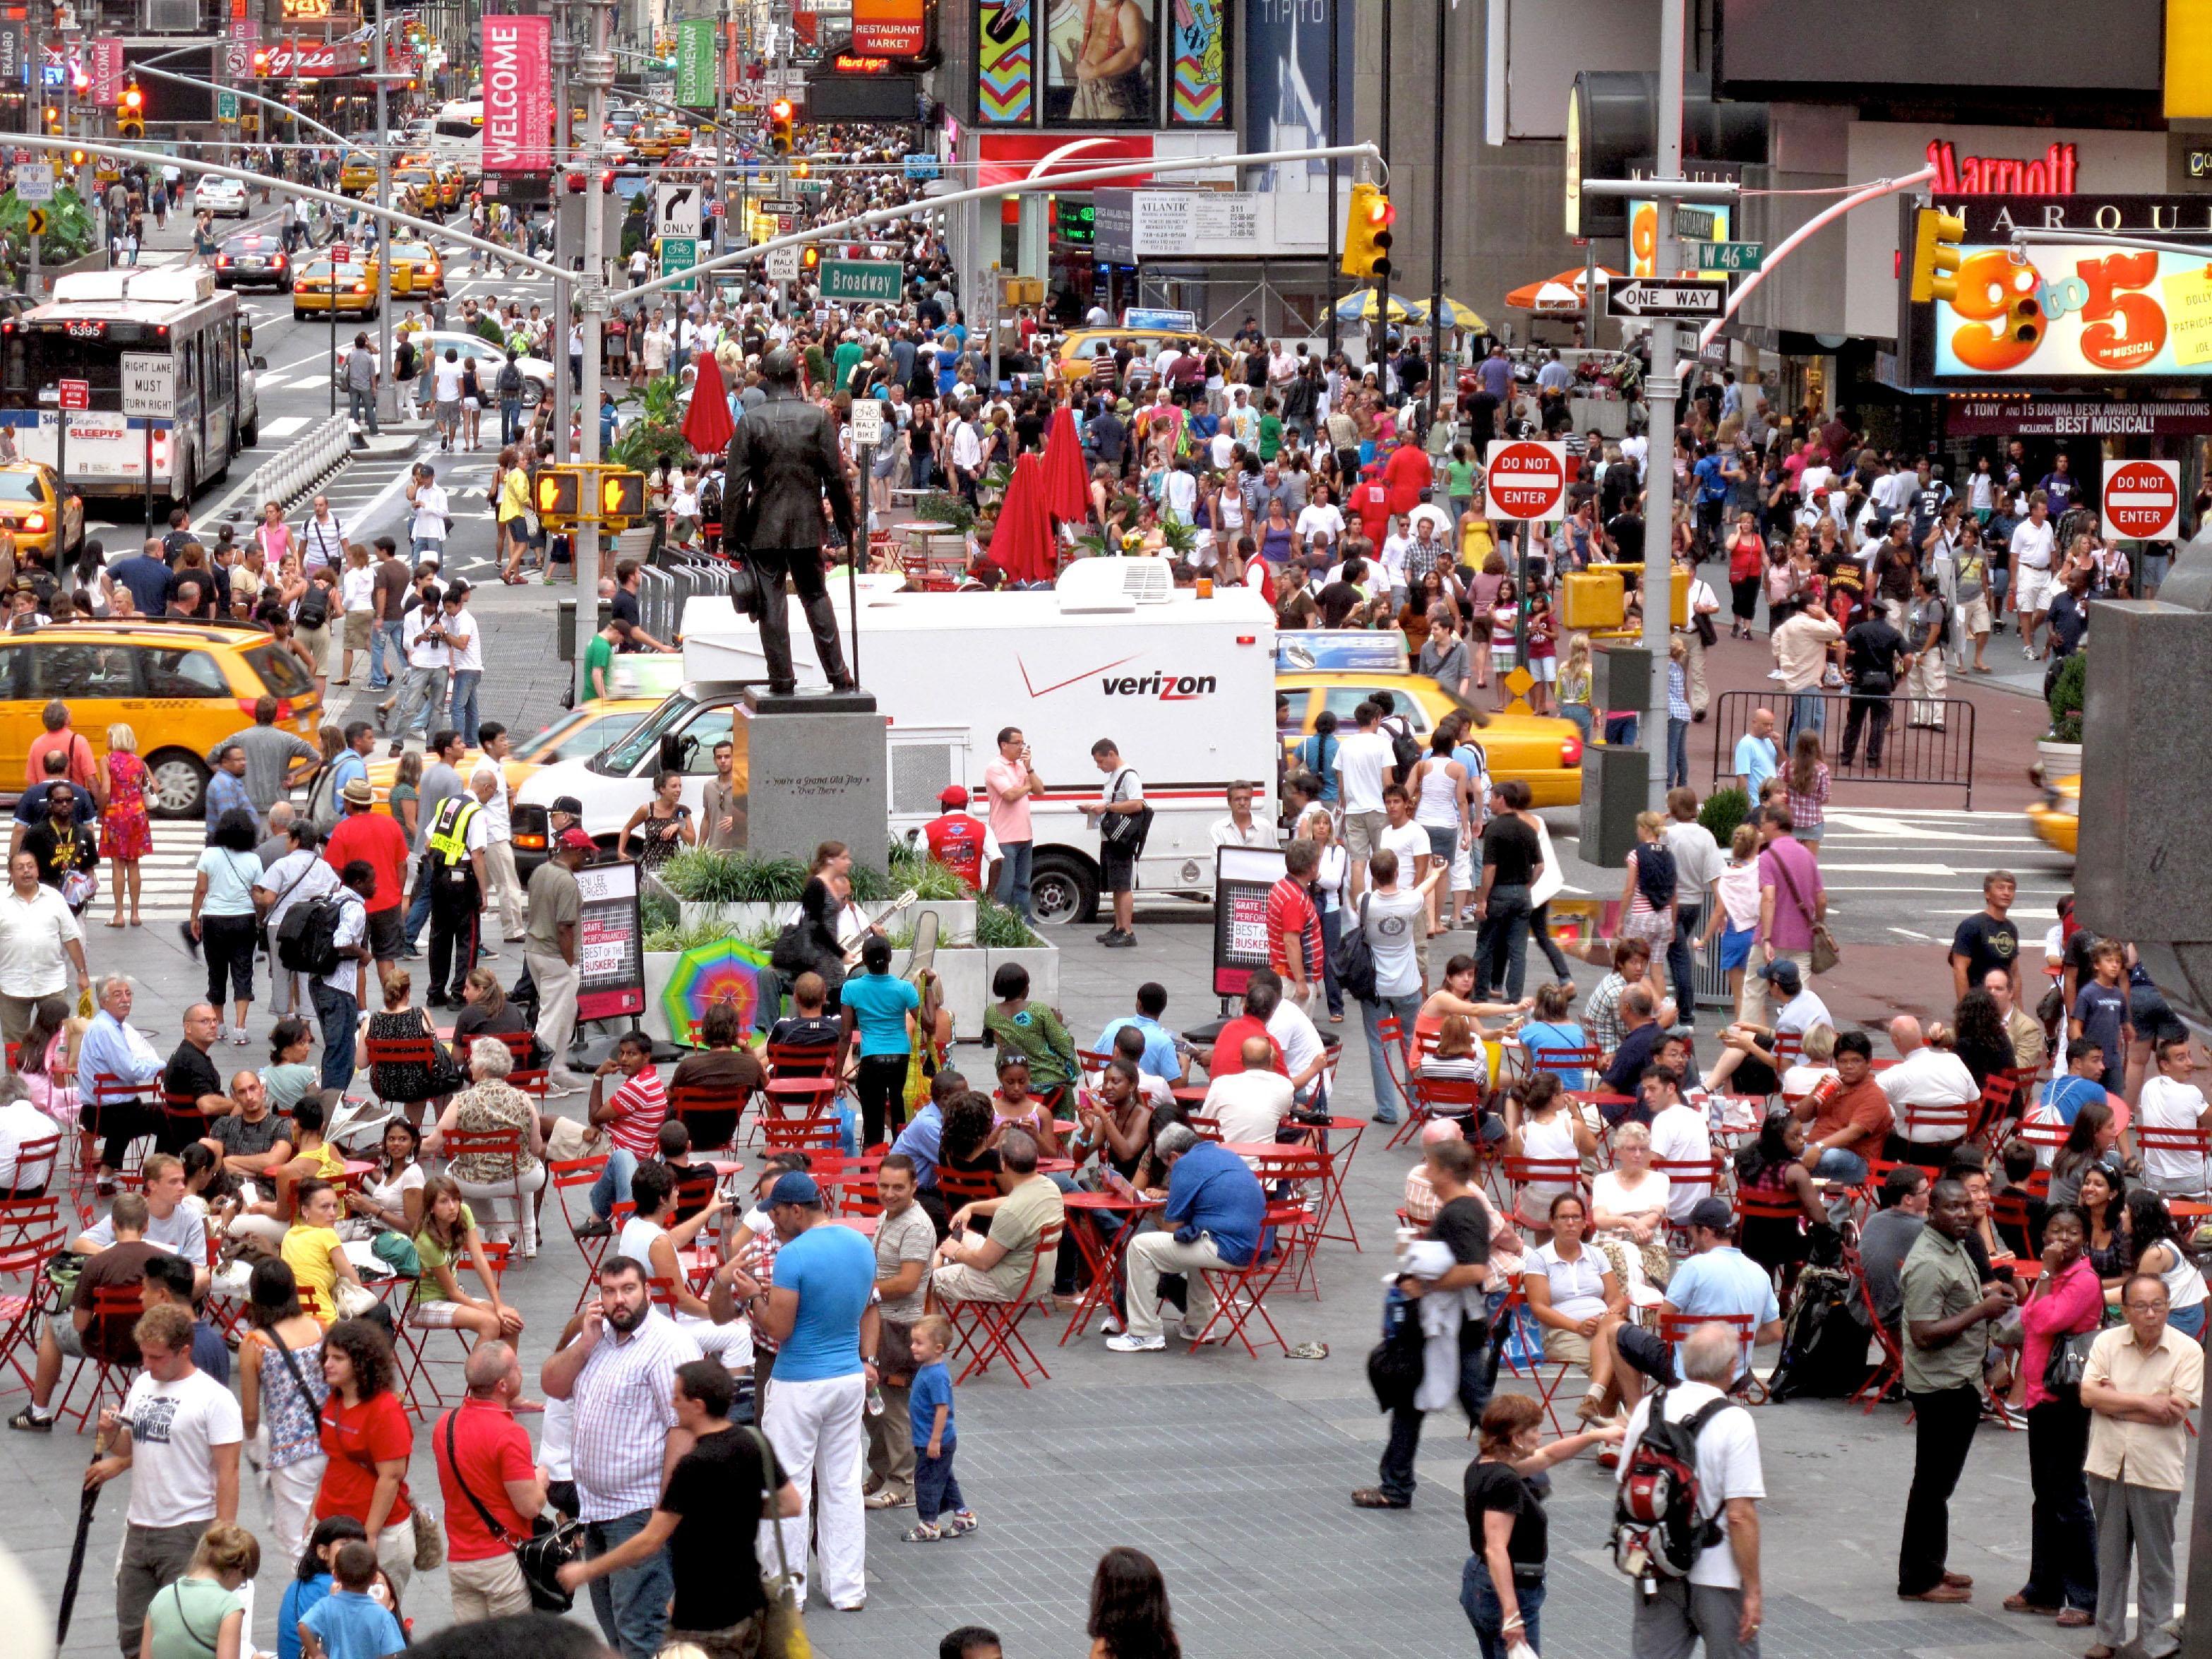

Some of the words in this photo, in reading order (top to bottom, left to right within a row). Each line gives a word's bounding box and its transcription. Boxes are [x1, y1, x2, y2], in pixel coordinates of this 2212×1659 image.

[856, 25, 921, 35] RESTAURANT
[539, 27, 549, 61] WORLD
[867, 39, 910, 48] MARKET
[838, 56, 864, 67] Hard
[98, 43, 109, 102] WELCOME
[539, 65, 548, 83] THE
[491, 27, 518, 163] WELCOME
[539, 86, 548, 97] OF
[527, 92, 537, 130] SQUARE
[539, 100, 549, 163] CROSSROADS
[1927, 138, 2078, 193] Marriott
[1141, 203, 1189, 212] ATLANTIC
[664, 223, 694, 234] ONLY
[1678, 211, 1714, 239] BROADWAY
[664, 258, 693, 266] Broadway
[774, 258, 794, 267] WALK
[1704, 245, 1716, 267] W
[1721, 246, 1740, 268] 46
[1745, 247, 1758, 258] ST
[772, 268, 795, 276] SIGNAL
[832, 270, 891, 297] Broadway
[1626, 290, 1659, 305] ONE
[1675, 291, 1711, 306] WAY
[1949, 249, 2047, 371] 9
[2076, 251, 2167, 371] 5
[70, 325, 100, 336] 6395
[1682, 333, 1695, 349] WAY
[2100, 348, 2112, 357] the
[2113, 341, 2154, 359] MUSICAL
[2195, 342, 2210, 354] JOE
[125, 361, 148, 371] RIGHT
[152, 363, 172, 373] LANE
[135, 379, 162, 393] MUST
[125, 398, 145, 409] TURN
[148, 400, 172, 410] RIGHT
[1964, 403, 1971, 417] 4
[2007, 407, 2020, 417] AND
[2023, 404, 2035, 417] 15
[2037, 404, 2073, 417] DRAMA
[2075, 403, 2102, 417] DESK
[2103, 403, 2139, 417] AWARD
[2141, 403, 2211, 417] NOMINATIONS
[42, 414, 73, 427] Slep
[856, 421, 877, 429] WALK
[2019, 424, 2054, 433] INCLUDING
[2055, 416, 2090, 433] BEST
[2091, 417, 2155, 433] MUSICAL!
[1502, 457, 1520, 469] DO
[1525, 457, 1550, 469] NOT
[2117, 477, 2135, 489] DO
[2140, 477, 2165, 489] NOT
[1504, 491, 1546, 504] ENTER
[1921, 491, 1939, 500] JETER
[1924, 499, 1936, 515] 2
[2120, 510, 2161, 523] ENTER
[1836, 568, 1860, 577] COMEDY
[1102, 670, 1216, 700] verizon
[803, 776, 827, 786] Grand
[830, 776, 843, 784] Old
[844, 774, 863, 786] Flag
[797, 786, 815, 795] Over
[817, 786, 837, 795] There
[593, 874, 605, 886] LEE
[582, 884, 608, 898] URGESS
[1236, 901, 1259, 911] GRATE
[583, 921, 602, 933] GRATE
[1236, 924, 1259, 936] BEST
[583, 930, 628, 945] PERFORMANCES
[1235, 938, 1269, 950] BUSKER
[585, 946, 603, 959] BEST
[604, 947, 611, 957] OF
[612, 946, 623, 955] THE
[585, 958, 616, 972] BUSKERS
